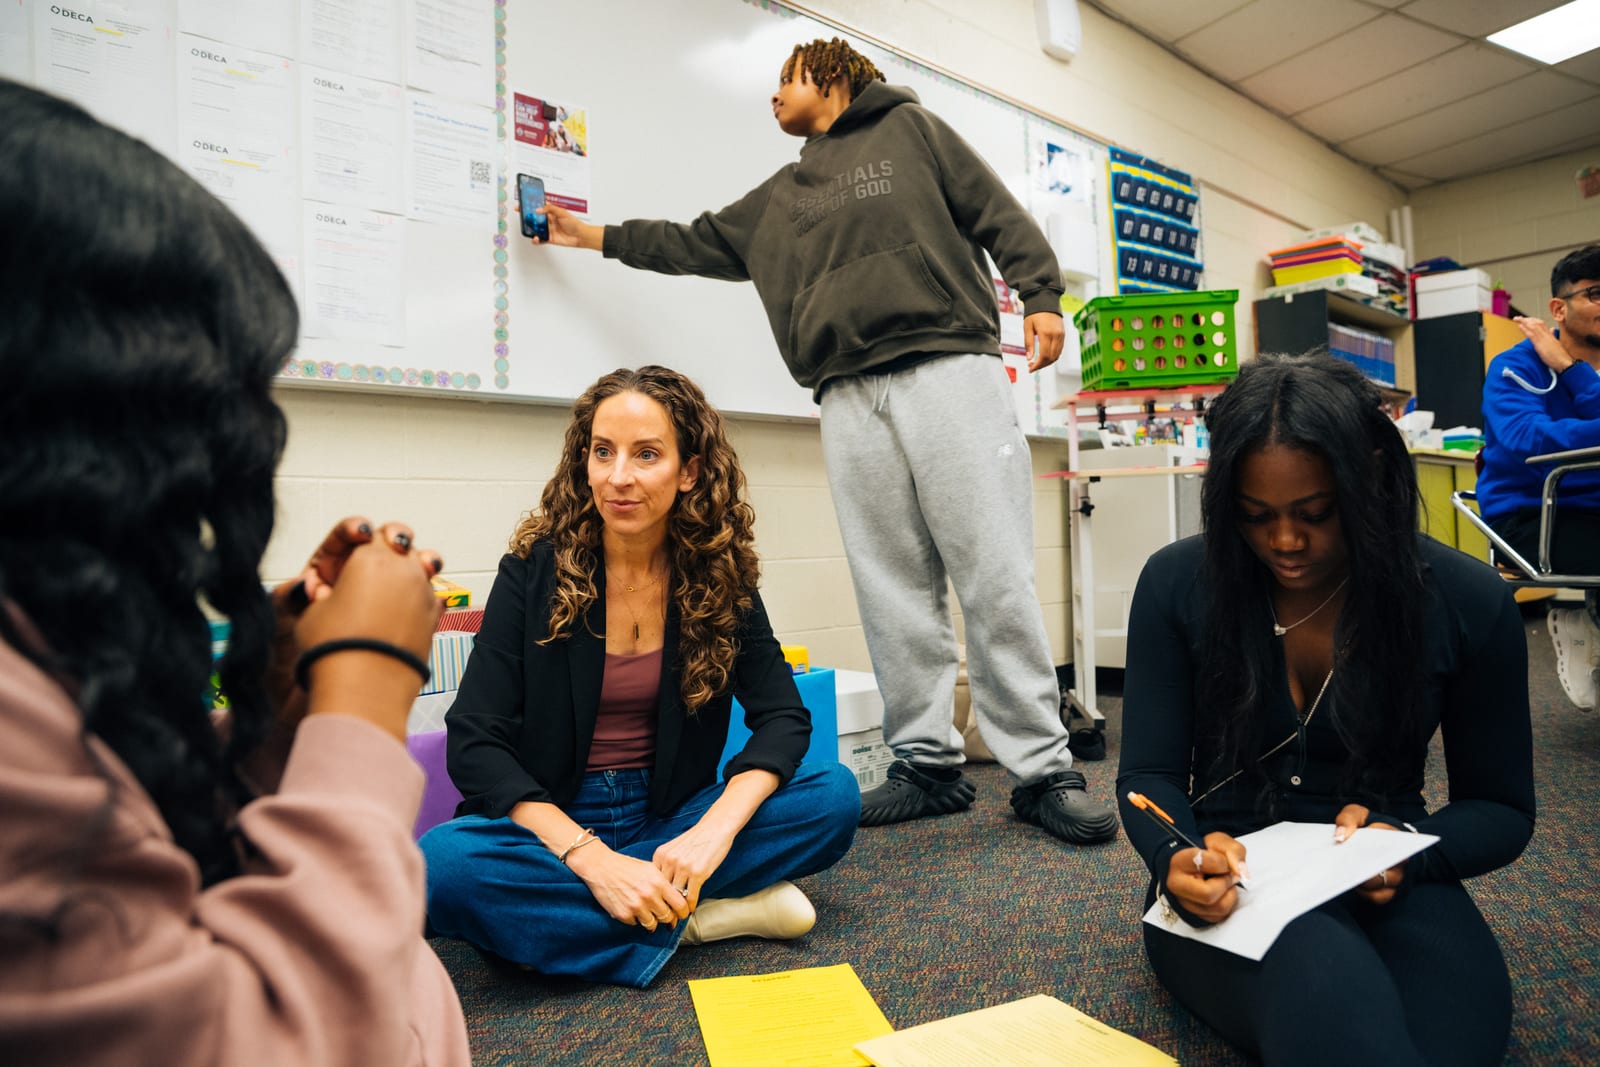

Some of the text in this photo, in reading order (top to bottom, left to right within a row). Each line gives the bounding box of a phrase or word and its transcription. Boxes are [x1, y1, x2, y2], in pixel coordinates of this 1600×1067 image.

[62, 9, 94, 25] DECA
[200, 50, 228, 64] DECA
[321, 80, 345, 92] DECA
[202, 141, 229, 155] DECA
[831, 189, 849, 212] OF
[855, 179, 892, 200] GOD
[324, 215, 347, 226] DECA
